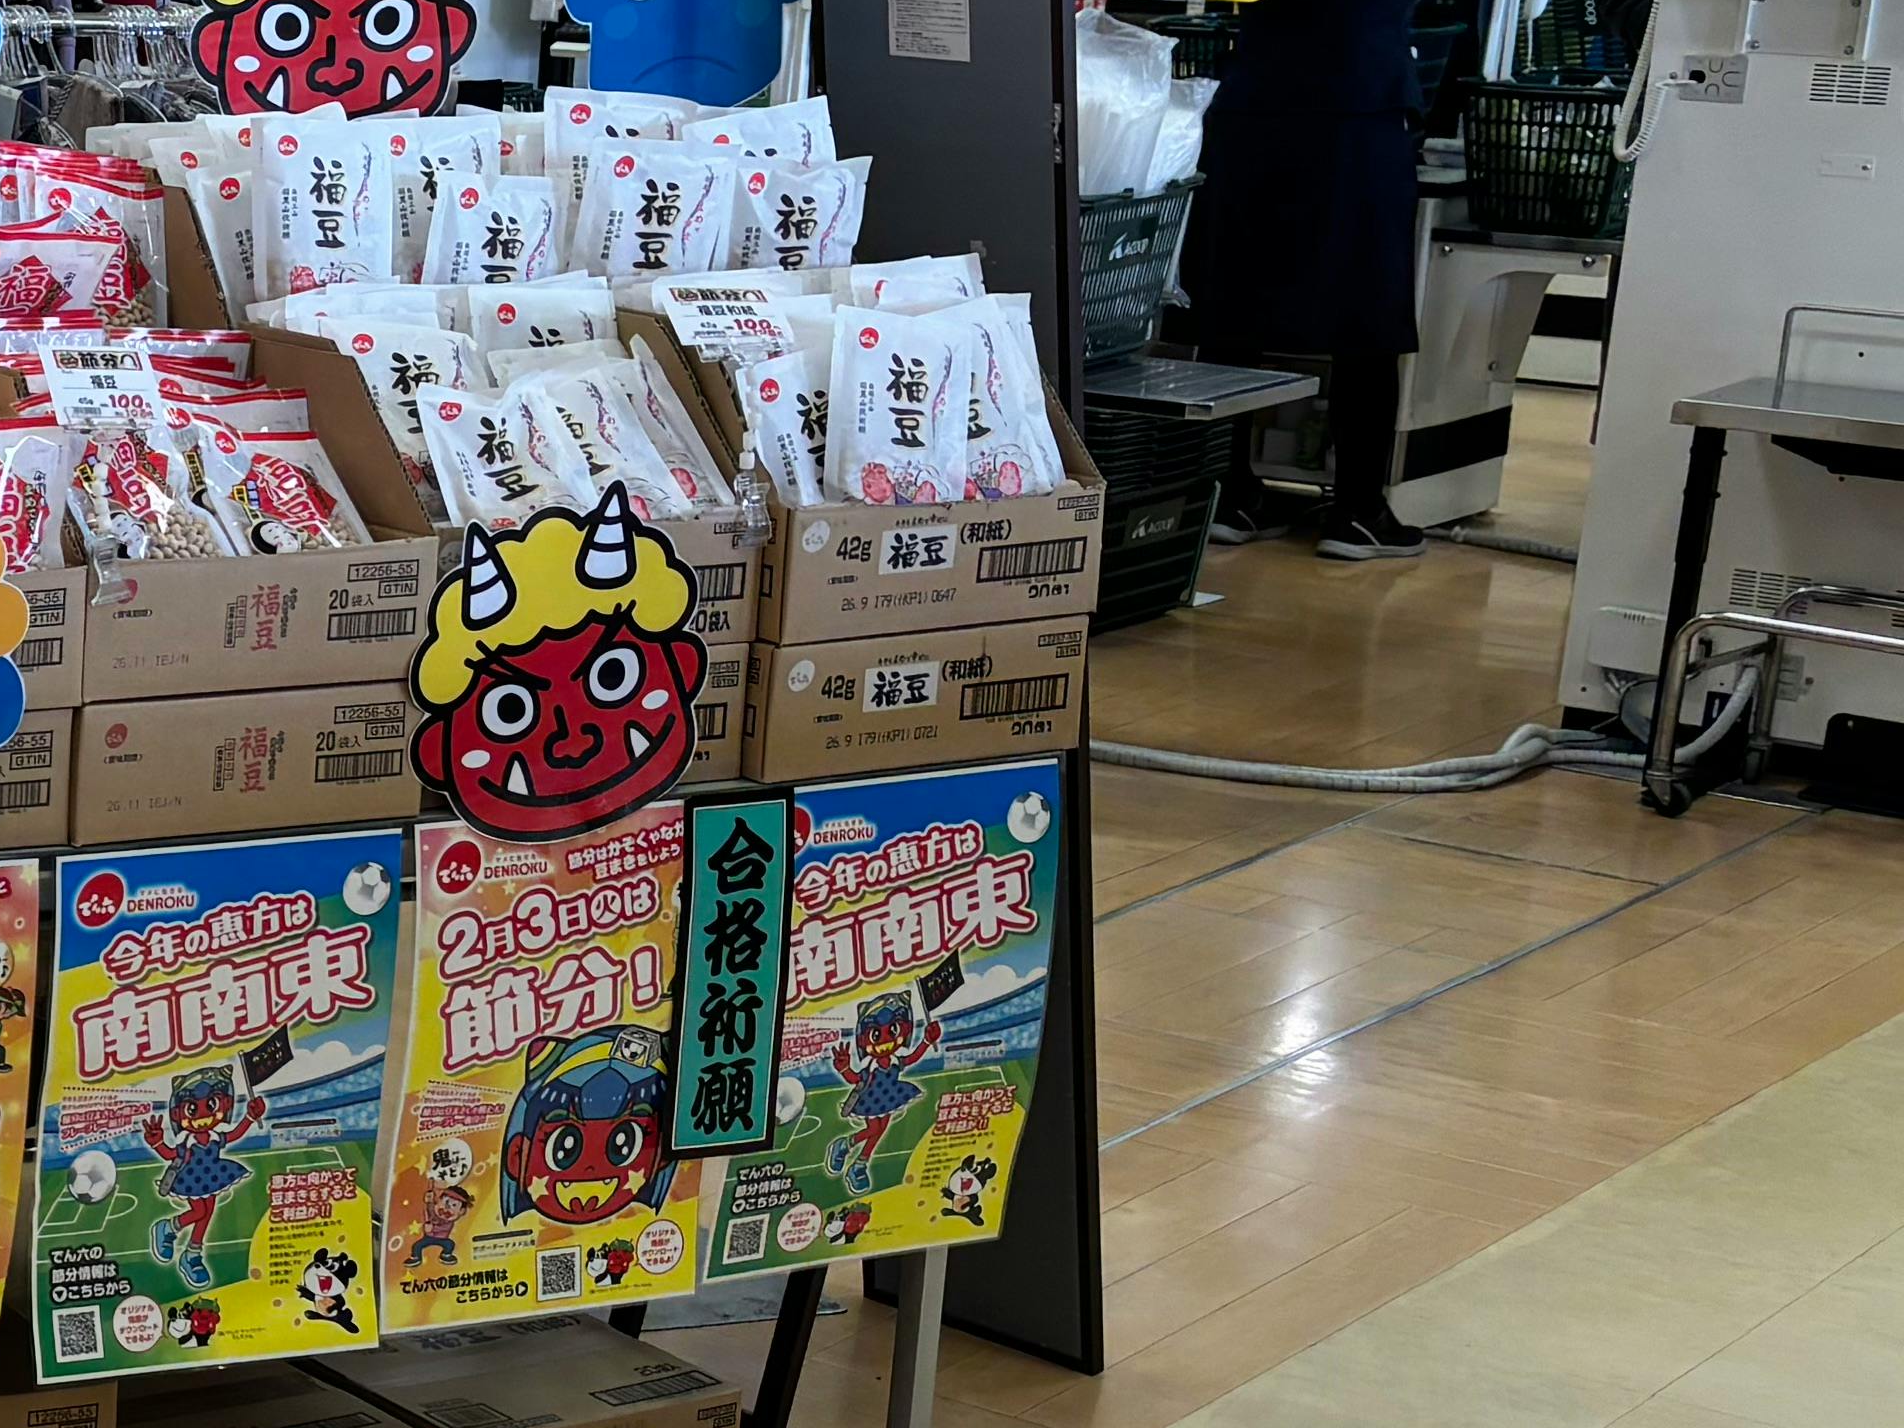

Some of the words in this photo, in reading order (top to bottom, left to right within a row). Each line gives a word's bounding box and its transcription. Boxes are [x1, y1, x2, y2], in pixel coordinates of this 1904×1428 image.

[310, 156, 348, 249] 福豆
[633, 178, 682, 270] 福豆
[89, 374, 119, 390] 福豆
[836, 536, 873, 561] 42g
[959, 518, 1013, 548] (和紙)
[356, 564, 412, 578] 12256-55
[328, 588, 377, 611] 20袋入
[384, 585, 414, 596] GTIN
[821, 671, 857, 701] 42g
[941, 654, 994, 685] (和紙)
[340, 707, 399, 721] 12256-55
[315, 730, 363, 753] 20袋入
[372, 725, 402, 737] GTIN
[794, 821, 981, 913] 今年の恵方は
[126, 892, 196, 914] DENROKU
[107, 894, 309, 976] 今年の恵方は
[786, 854, 1036, 1002] 南南東
[692, 816, 772, 1134] 合格祈願
[76, 928, 374, 1072] 南南東
[446, 945, 660, 1072] 節分!
[50, 1245, 104, 1264] でん六の
[51, 1262, 116, 1281] 節分情報は
[398, 1266, 510, 1295] でん六の節分情報は
